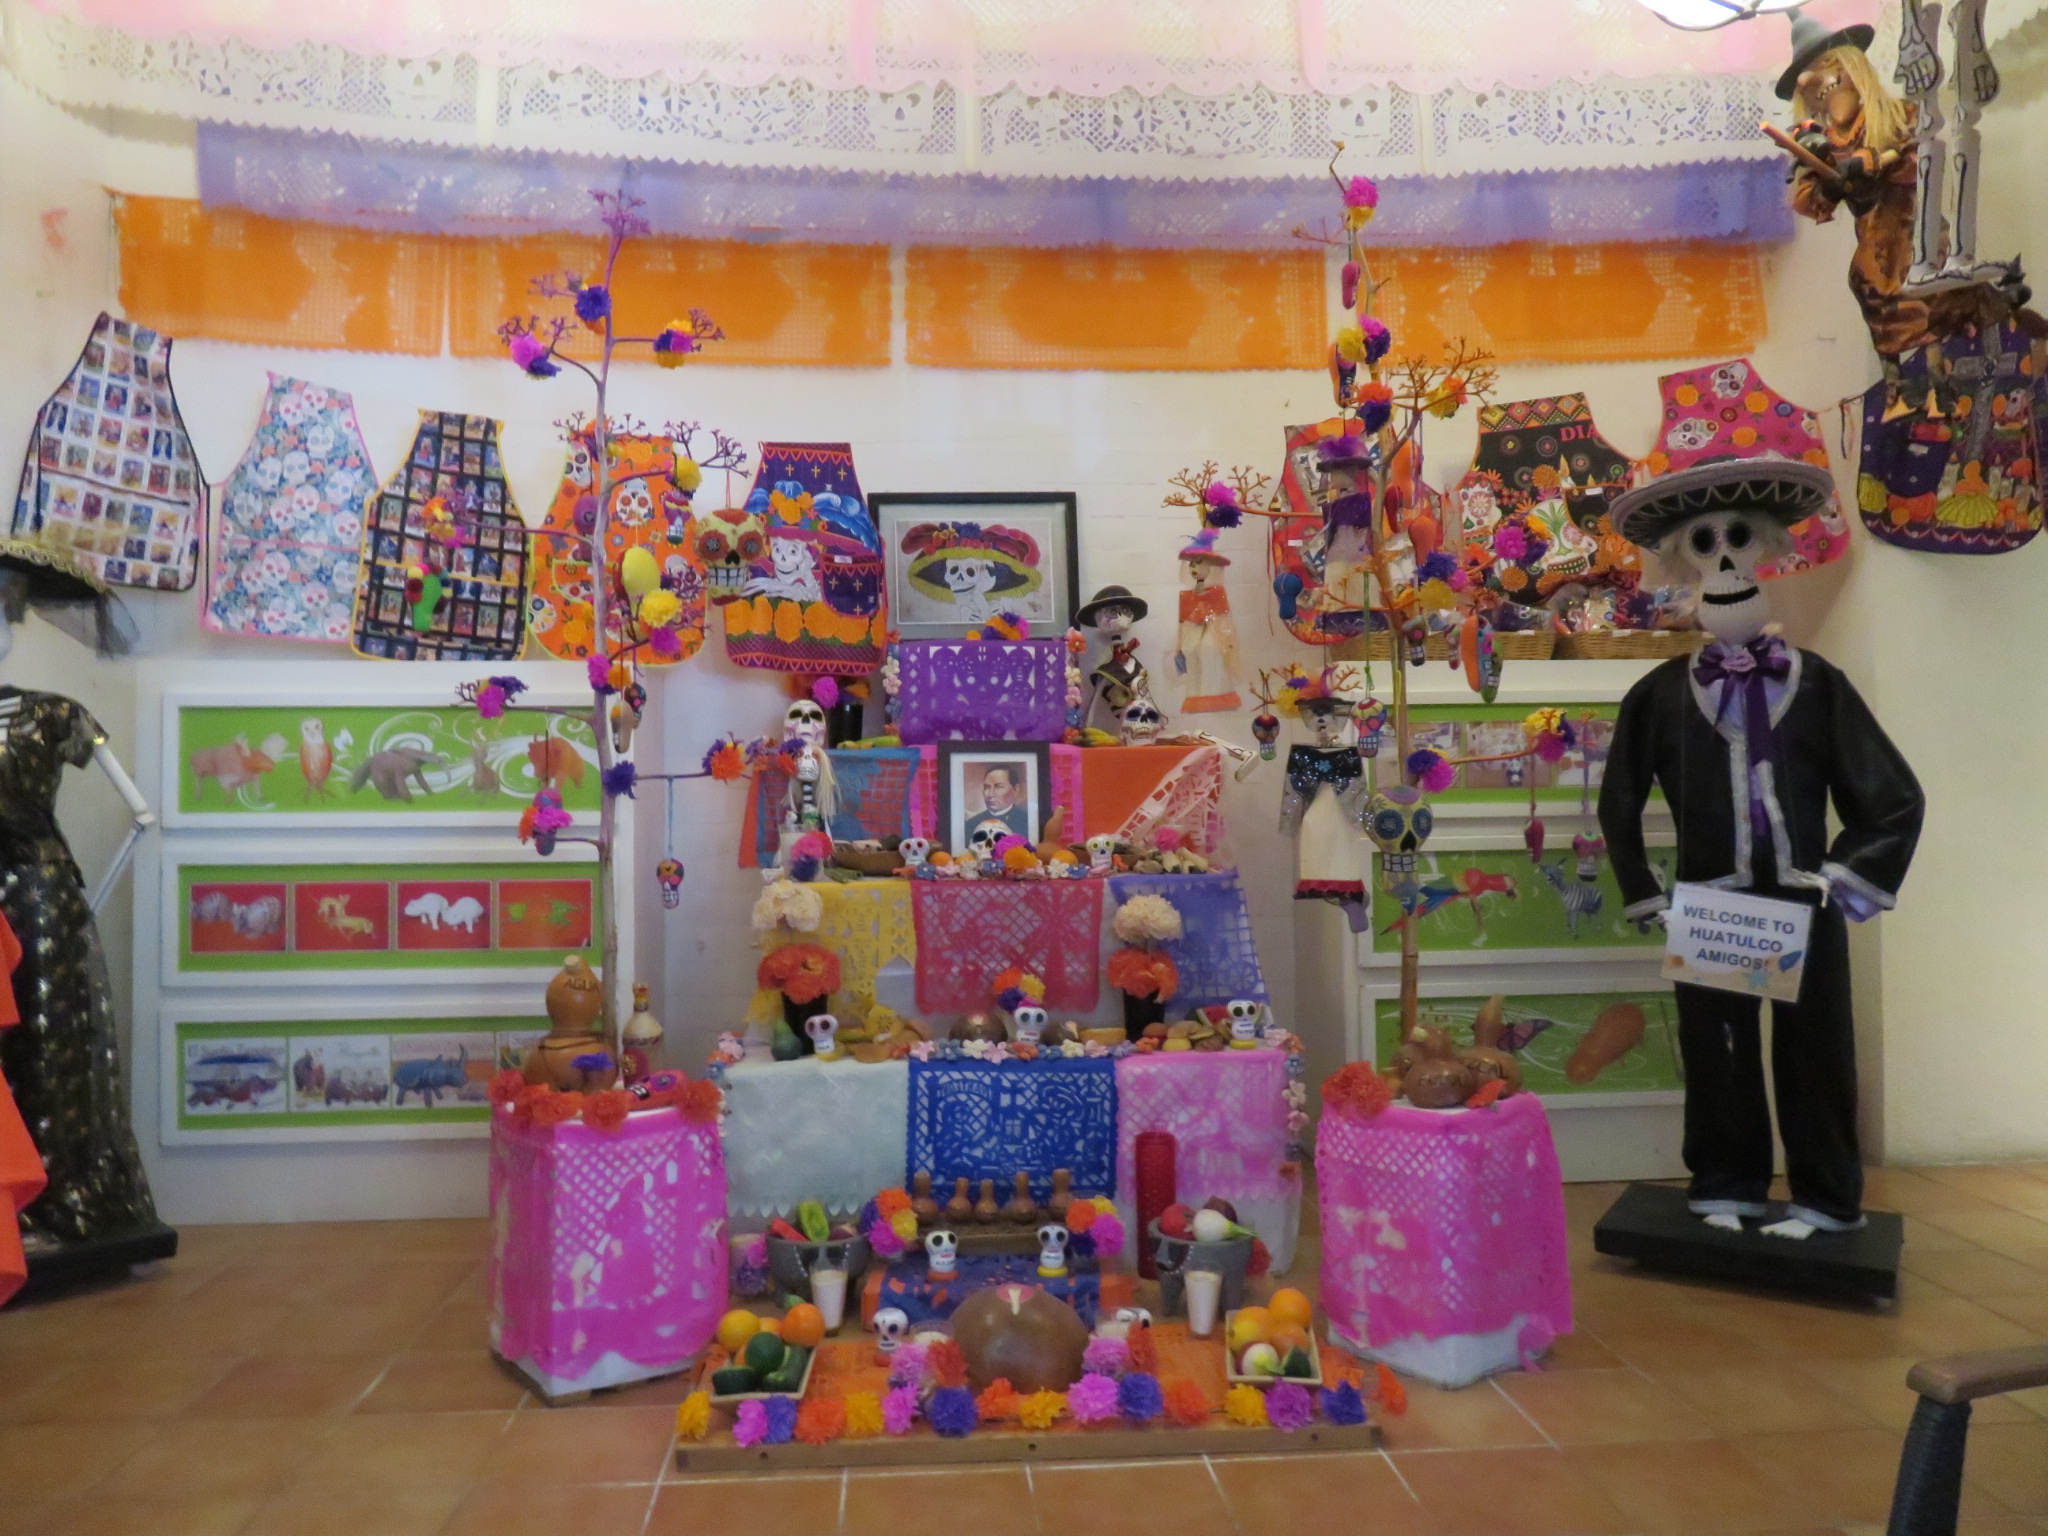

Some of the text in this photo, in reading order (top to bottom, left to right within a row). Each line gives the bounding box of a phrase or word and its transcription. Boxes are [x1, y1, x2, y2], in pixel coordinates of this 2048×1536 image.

[1684, 904, 1795, 935] WELCOME TO
[1689, 926, 1783, 953] HUATULCO
